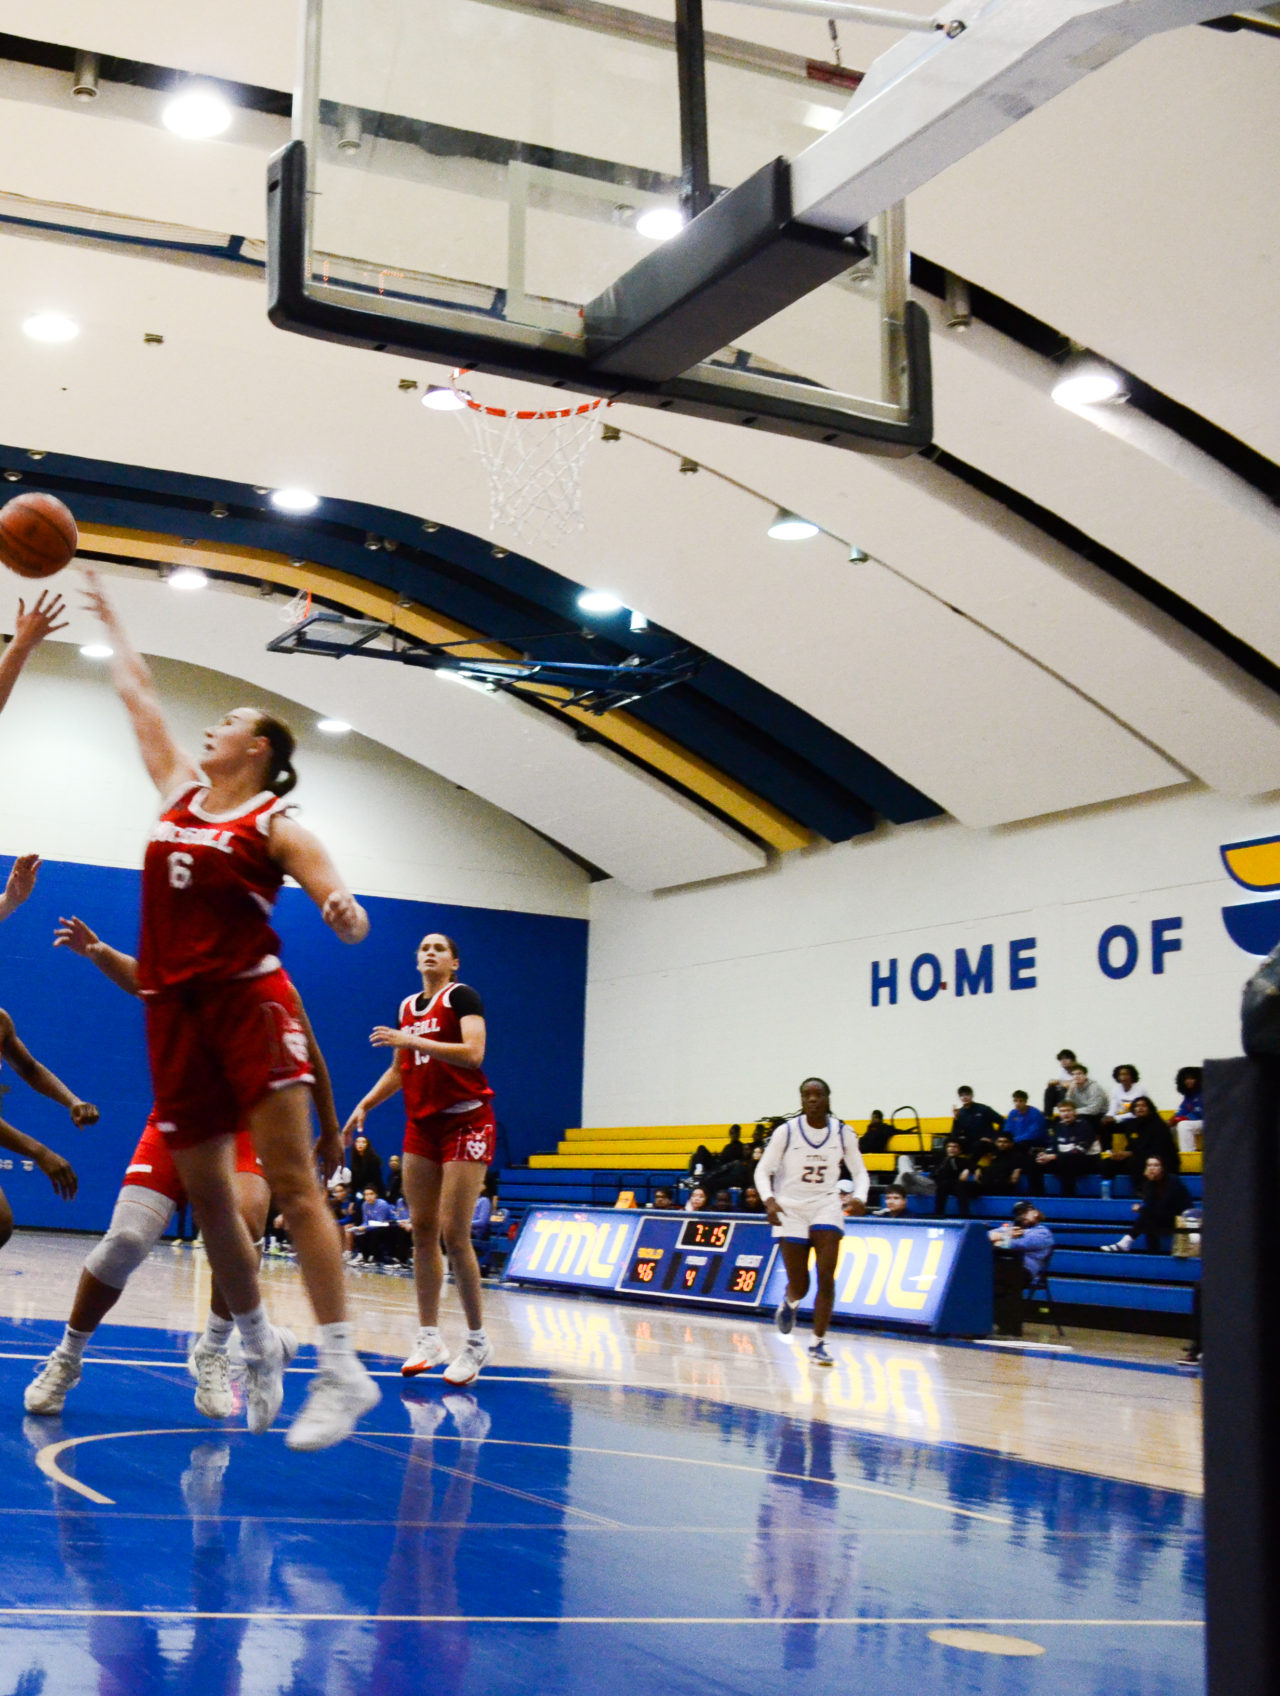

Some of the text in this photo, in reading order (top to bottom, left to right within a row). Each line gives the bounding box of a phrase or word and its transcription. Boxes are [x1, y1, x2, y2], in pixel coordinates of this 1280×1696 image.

[168, 851, 195, 889] 6
[871, 916, 1183, 1007] HOME OF
[801, 1166, 828, 1184] 25
[694, 1224, 728, 1246] 7:15
[527, 1219, 630, 1279] TMU
[636, 1262, 656, 1282] 46
[684, 1269, 697, 1287] 4
[732, 1270, 757, 1292] 38
